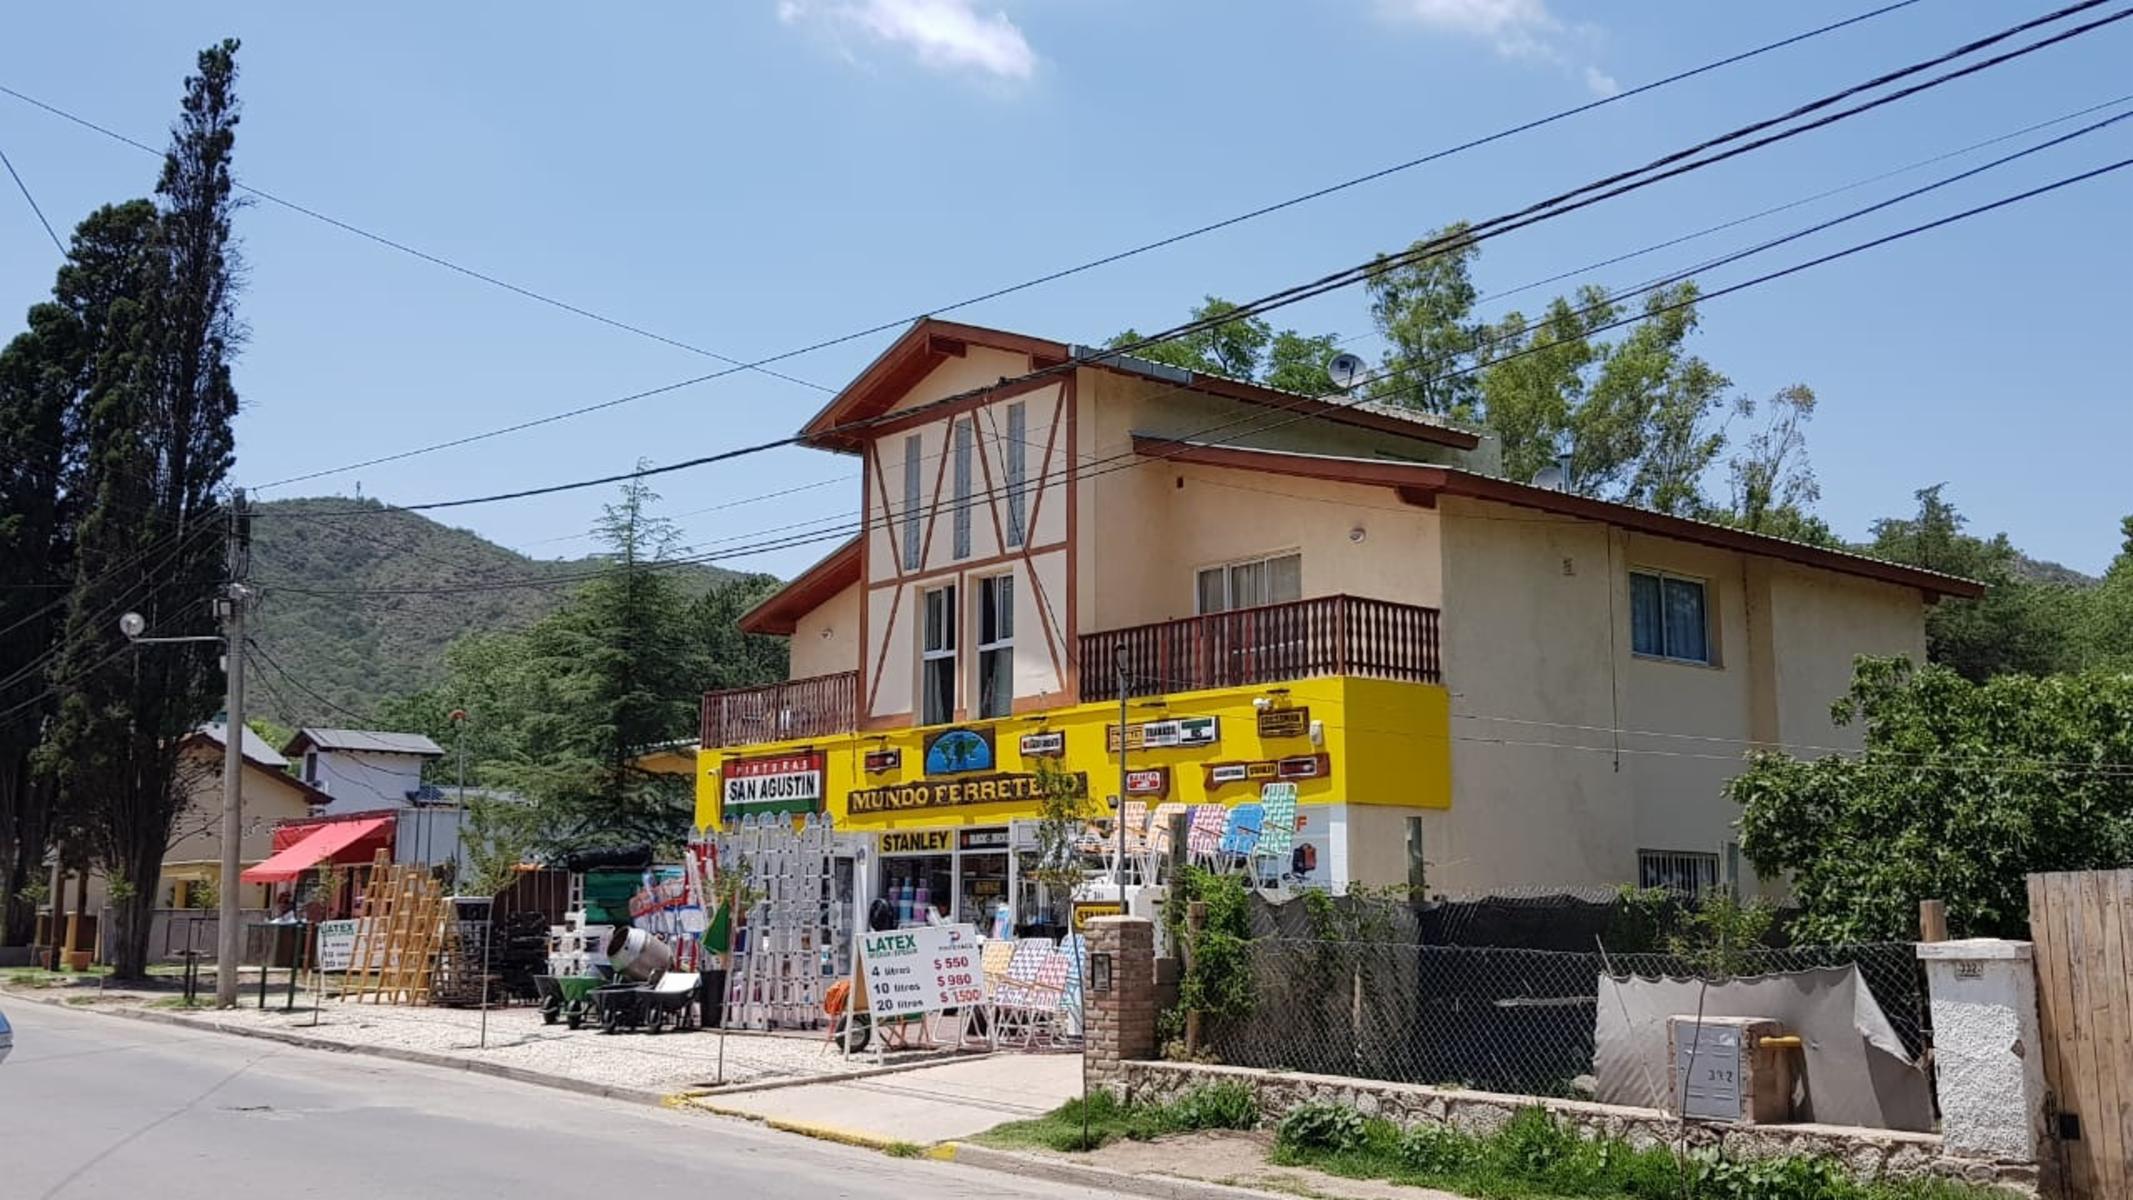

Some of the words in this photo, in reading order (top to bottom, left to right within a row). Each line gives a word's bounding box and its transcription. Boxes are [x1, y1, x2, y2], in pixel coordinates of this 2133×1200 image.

[729, 780, 756, 801] SAN
[760, 773, 815, 799] AGUSTIN
[852, 788, 929, 810] MUNDO
[883, 831, 949, 851] STANLEY
[866, 934, 916, 953] LATEX
[871, 966, 880, 976] 4
[945, 956, 969, 969] 550
[874, 983, 890, 994] 10
[894, 983, 921, 992] litros
[947, 973, 972, 986] 980
[876, 999, 894, 1011] 20
[953, 988, 981, 1003] 1500
